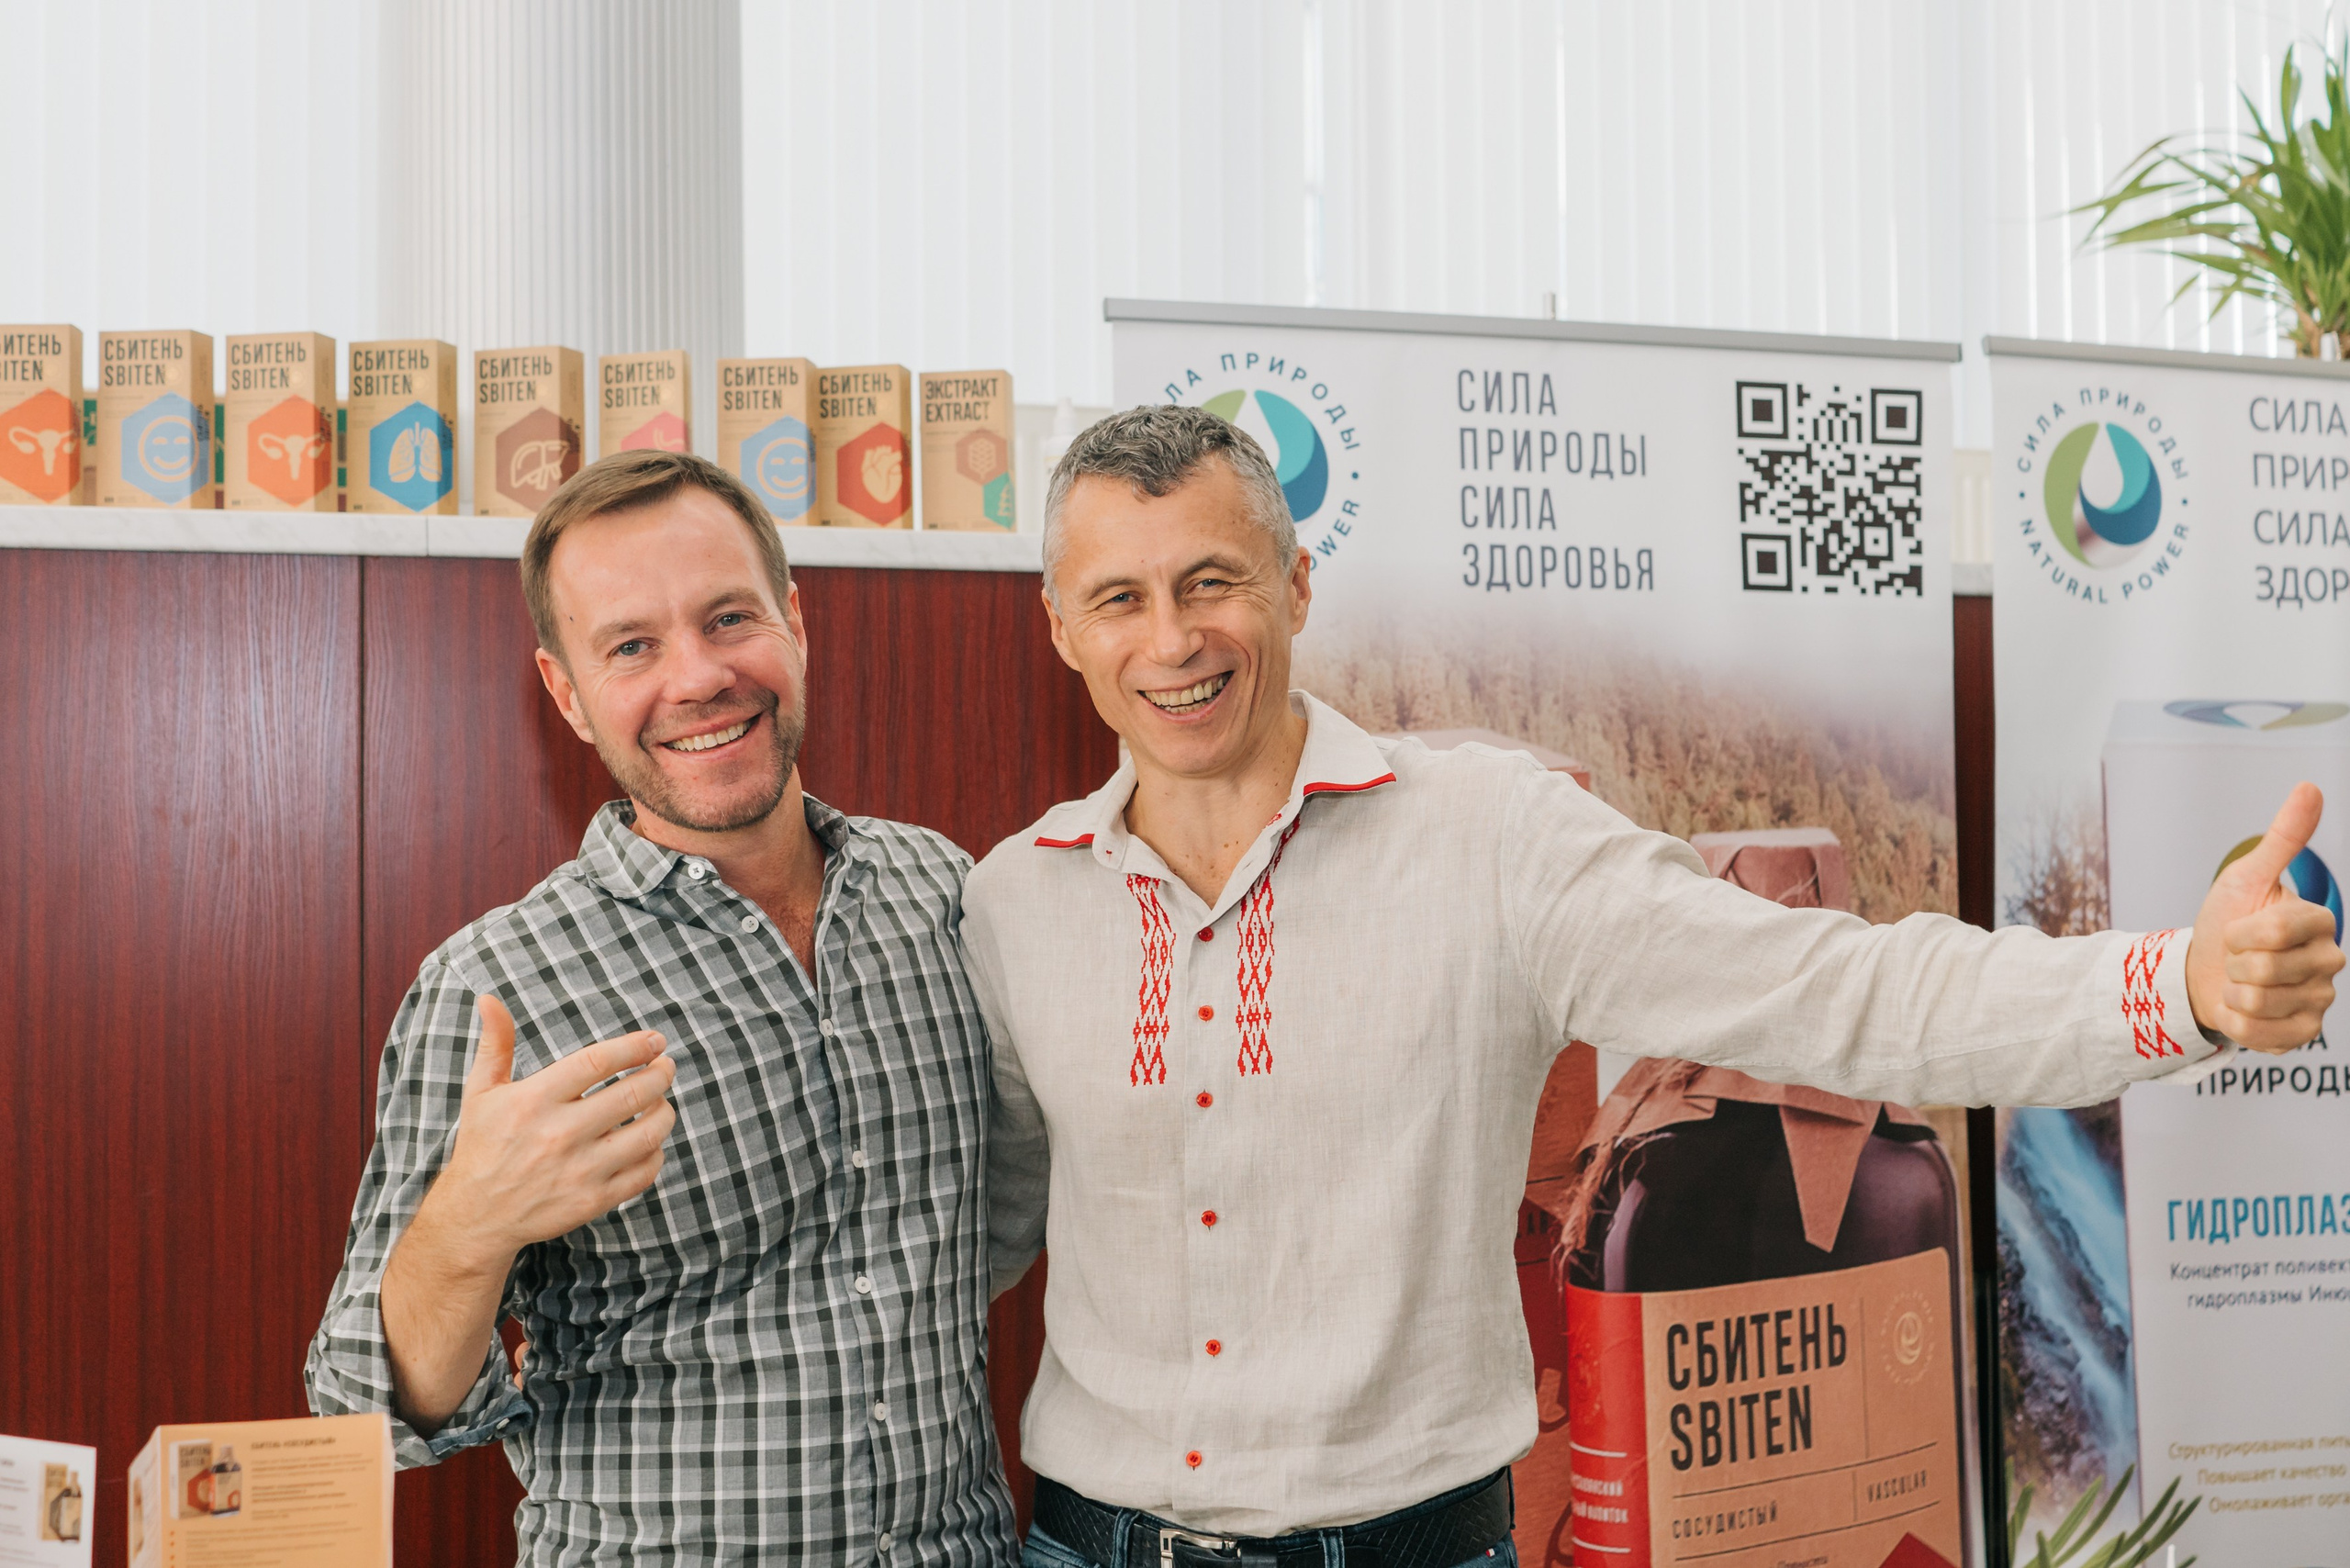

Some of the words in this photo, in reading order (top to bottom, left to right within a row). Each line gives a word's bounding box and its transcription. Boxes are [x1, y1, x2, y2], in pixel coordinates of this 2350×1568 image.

[0, 332, 62, 356] ИТЕНЬ
[104, 338, 183, 361] СБИТЕНЬ
[230, 342, 307, 365] СБИТЕНЬ
[0, 359, 44, 382] ITEN
[353, 348, 430, 373] СБИТЕНЬ
[479, 354, 553, 380] СБИТЕНЬ
[104, 364, 166, 386] SBITEN
[230, 367, 290, 391] SBITEN
[353, 373, 413, 397] SBITEN
[604, 361, 676, 385] СБИТЕНЬ
[723, 364, 799, 387] СБИТЕНЬ
[819, 372, 892, 396] СБИТЕНЬ
[479, 380, 536, 404] SBITEN
[604, 385, 660, 409] SBITEN
[723, 388, 782, 411] SBITEN
[925, 377, 998, 400] ЭКСТРАКТ
[1457, 369, 1557, 416] СИЛА
[819, 396, 877, 419] SBITEN
[925, 400, 990, 423] EXTRACT
[1220, 353, 1360, 450] ПРИРОДЫ
[2248, 396, 2347, 436] СИЛА
[2017, 402, 2065, 473] СИЛА
[2079, 387, 2188, 479] ПРИРОДЫ
[1459, 427, 1647, 480] ПРИРОДЫ
[1460, 485, 1557, 531] СИЛА
[2253, 510, 2350, 546] СИЛА
[1463, 543, 1654, 592] ЗДОРОВЬЯ
[2020, 519, 2109, 604] NATURAL
[2122, 523, 2189, 599] POWER
[2197, 1065, 2350, 1097] ПРИРОД
[2170, 1260, 2270, 1281] Концентрат
[2188, 1289, 2302, 1310] гидроплазмы
[1666, 1303, 1847, 1391] СБИТЕНЬ
[1670, 1384, 1813, 1471] SBITEN
[1866, 1469, 1928, 1503] VASCULAR
[1672, 1499, 1777, 1540] СОСУДИСТЫЙ
